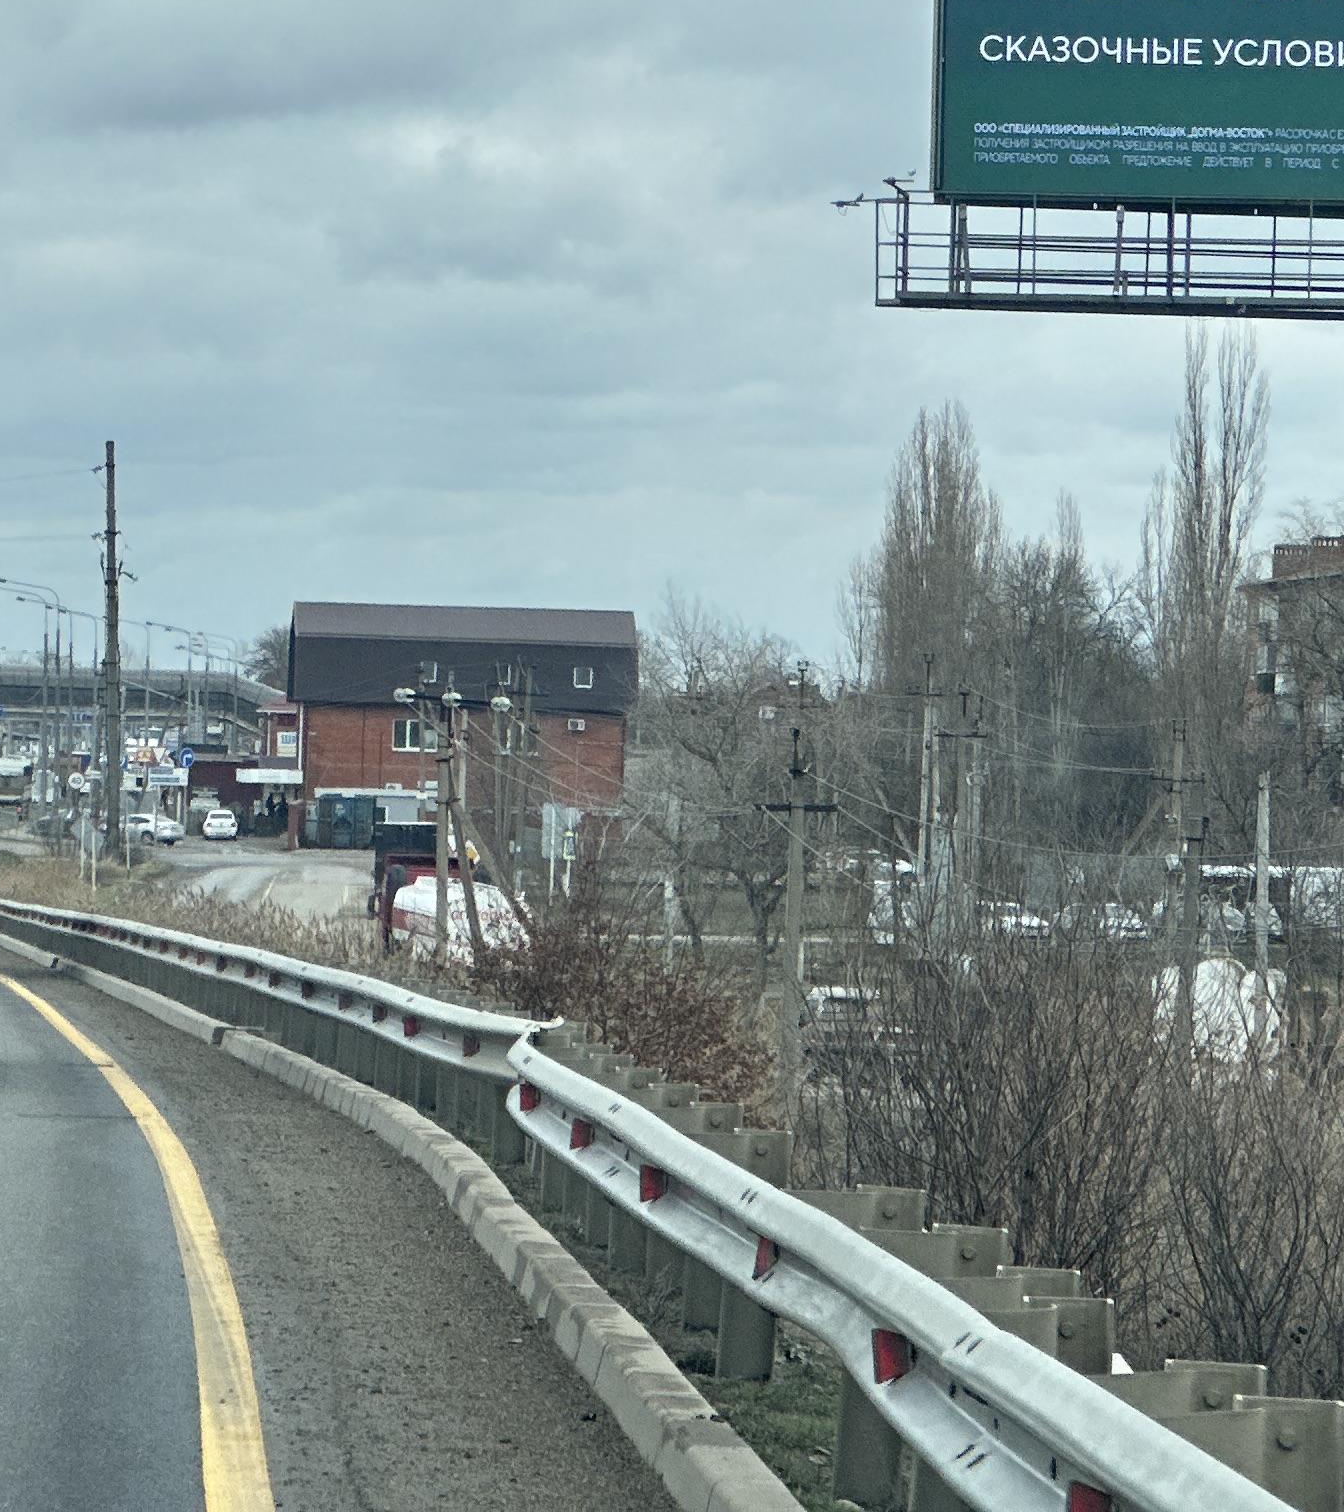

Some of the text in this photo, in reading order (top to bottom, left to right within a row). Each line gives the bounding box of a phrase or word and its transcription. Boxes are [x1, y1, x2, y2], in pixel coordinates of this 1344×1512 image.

[978, 34, 1205, 67] СКАЗОЧНЫЕ
[974, 122, 997, 133] ООО
[1121, 124, 1186, 138] ЗАСТРОЙЩИК
[1276, 128, 1329, 139] РАССРОЧКА
[974, 137, 1029, 148] ПОЛУЧЕНИЯ
[1031, 136, 1111, 150] ЗАСТРОЙЩИКОМ
[1113, 140, 1173, 151] РАЗРЕШЕНИЯ
[1176, 141, 1188, 151] НА
[1191, 141, 1217, 153] ВВОД
[1219, 142, 1227, 152] В
[1228, 142, 1303, 154] ЭКСПЛУАТАЦИЮ
[974, 152, 1058, 164] ПРИОБРЕТАЕМОГО
[1122, 155, 1192, 167] ПРЕДЛОЖЕНИЕ
[1203, 154, 1254, 168] ДЕЙСТВУЕТ
[1265, 157, 1272, 168] В
[1283, 158, 1321, 169] ПЕРИОД
[1332, 159, 1339, 169] С
